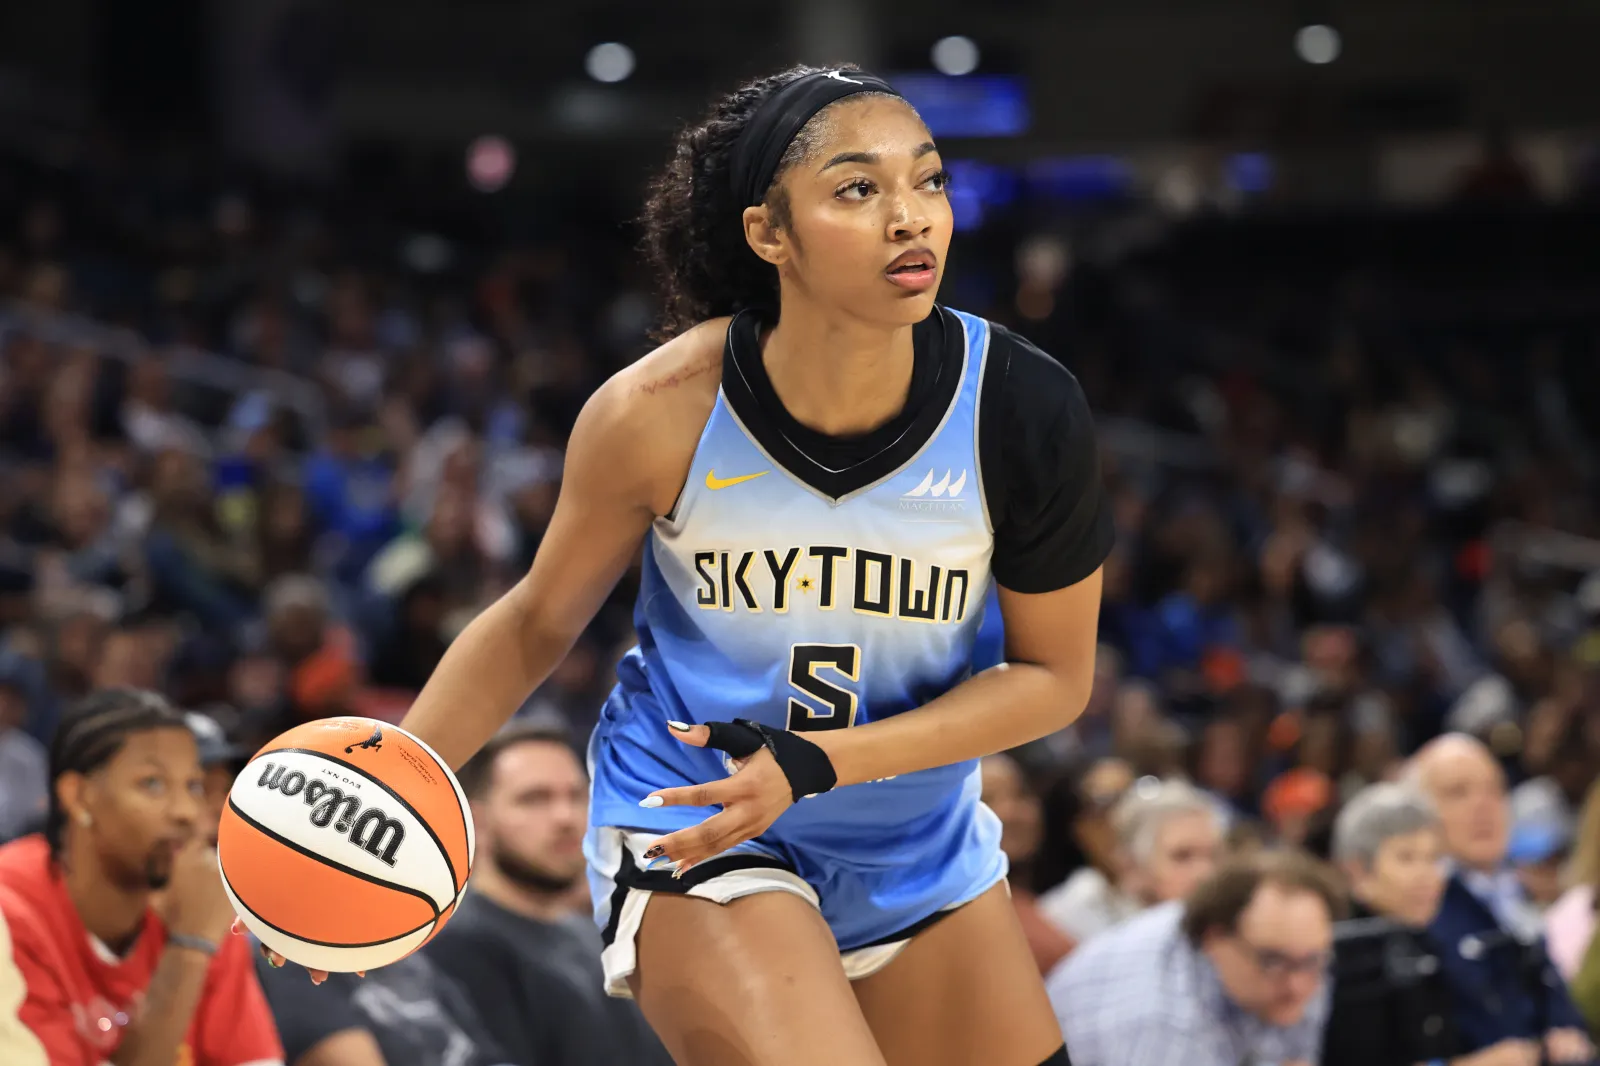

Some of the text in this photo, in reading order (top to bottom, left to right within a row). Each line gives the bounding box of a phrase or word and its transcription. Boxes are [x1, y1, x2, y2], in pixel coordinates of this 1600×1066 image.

[786, 642, 861, 732] 5
[256, 762, 407, 868] Wilson
[321, 768, 362, 790] EVO NXT
